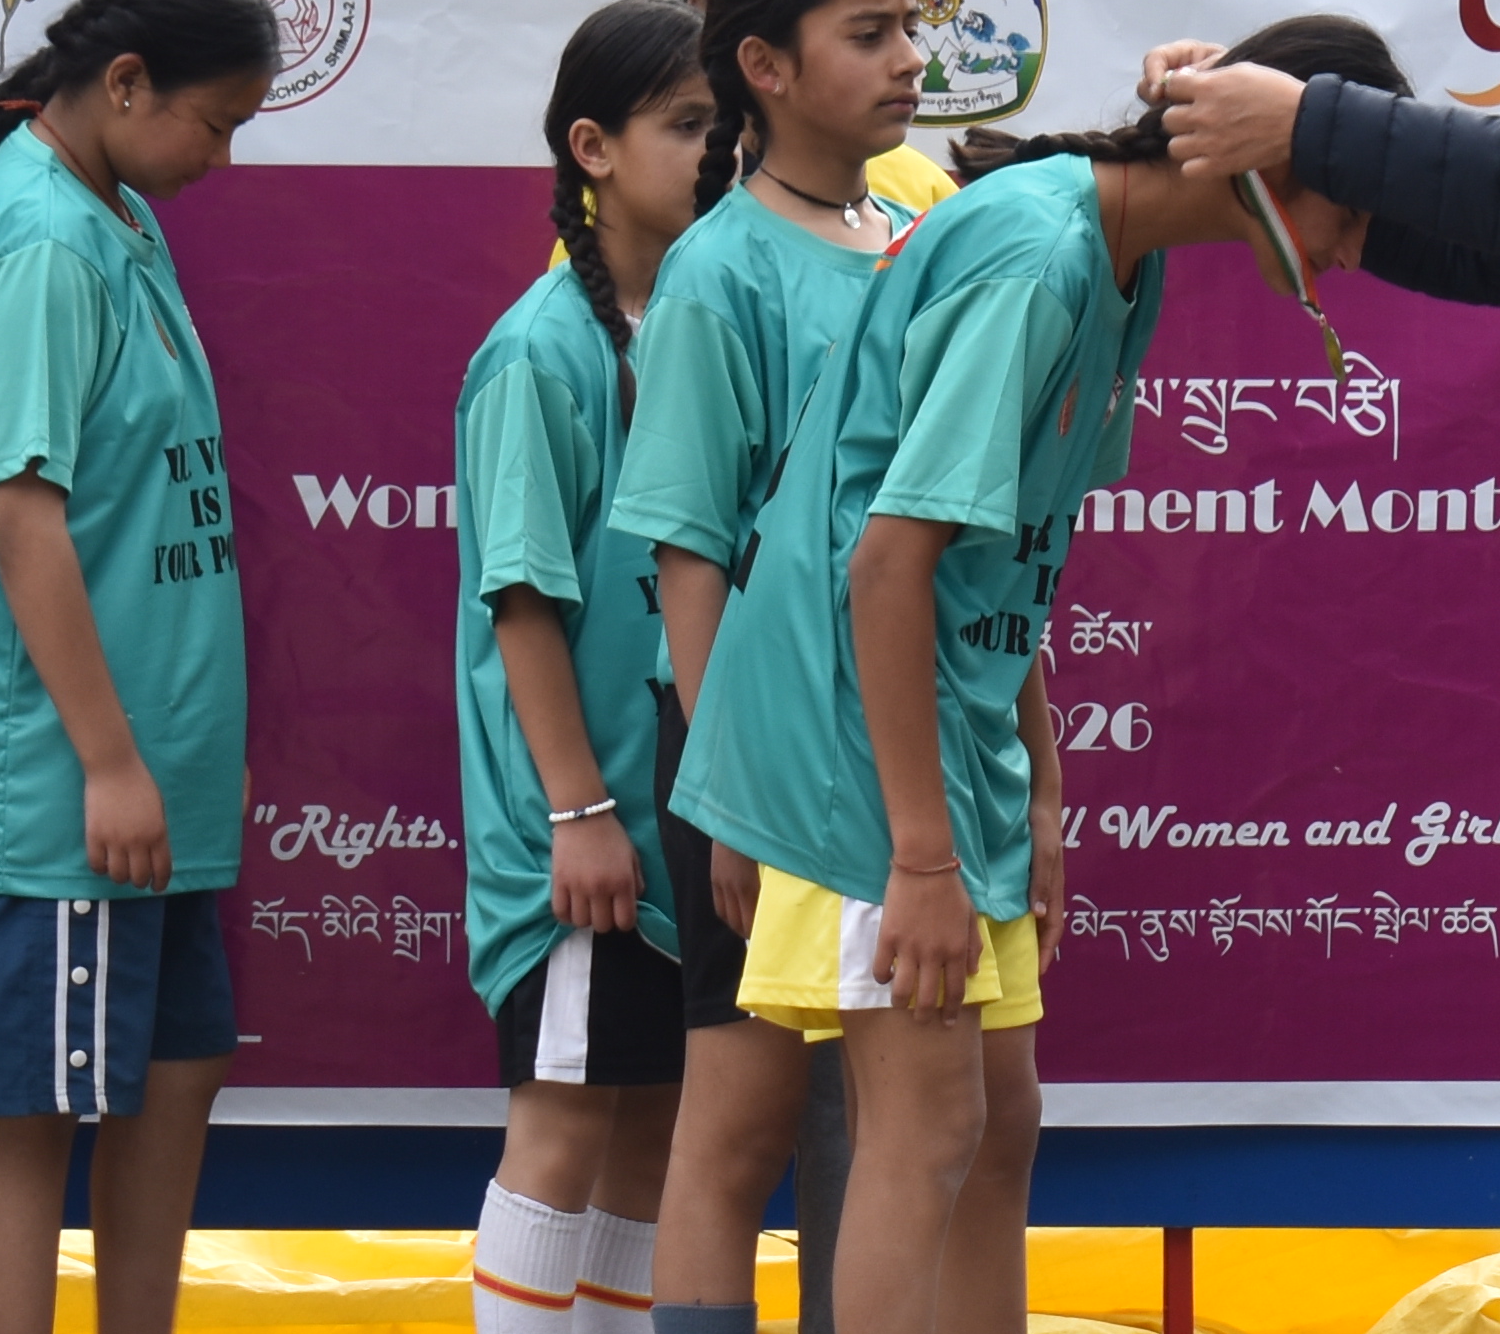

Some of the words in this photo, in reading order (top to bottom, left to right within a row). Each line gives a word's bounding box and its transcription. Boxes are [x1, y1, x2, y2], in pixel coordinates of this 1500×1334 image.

[266, 70, 330, 101] SCHOOL,
[324, 1, 356, 68] SHIMLA-2
[190, 486, 222, 528] IS
[253, 803, 459, 870] "Rights.
[1100, 805, 1290, 849] Women
[1305, 802, 1397, 848] and
